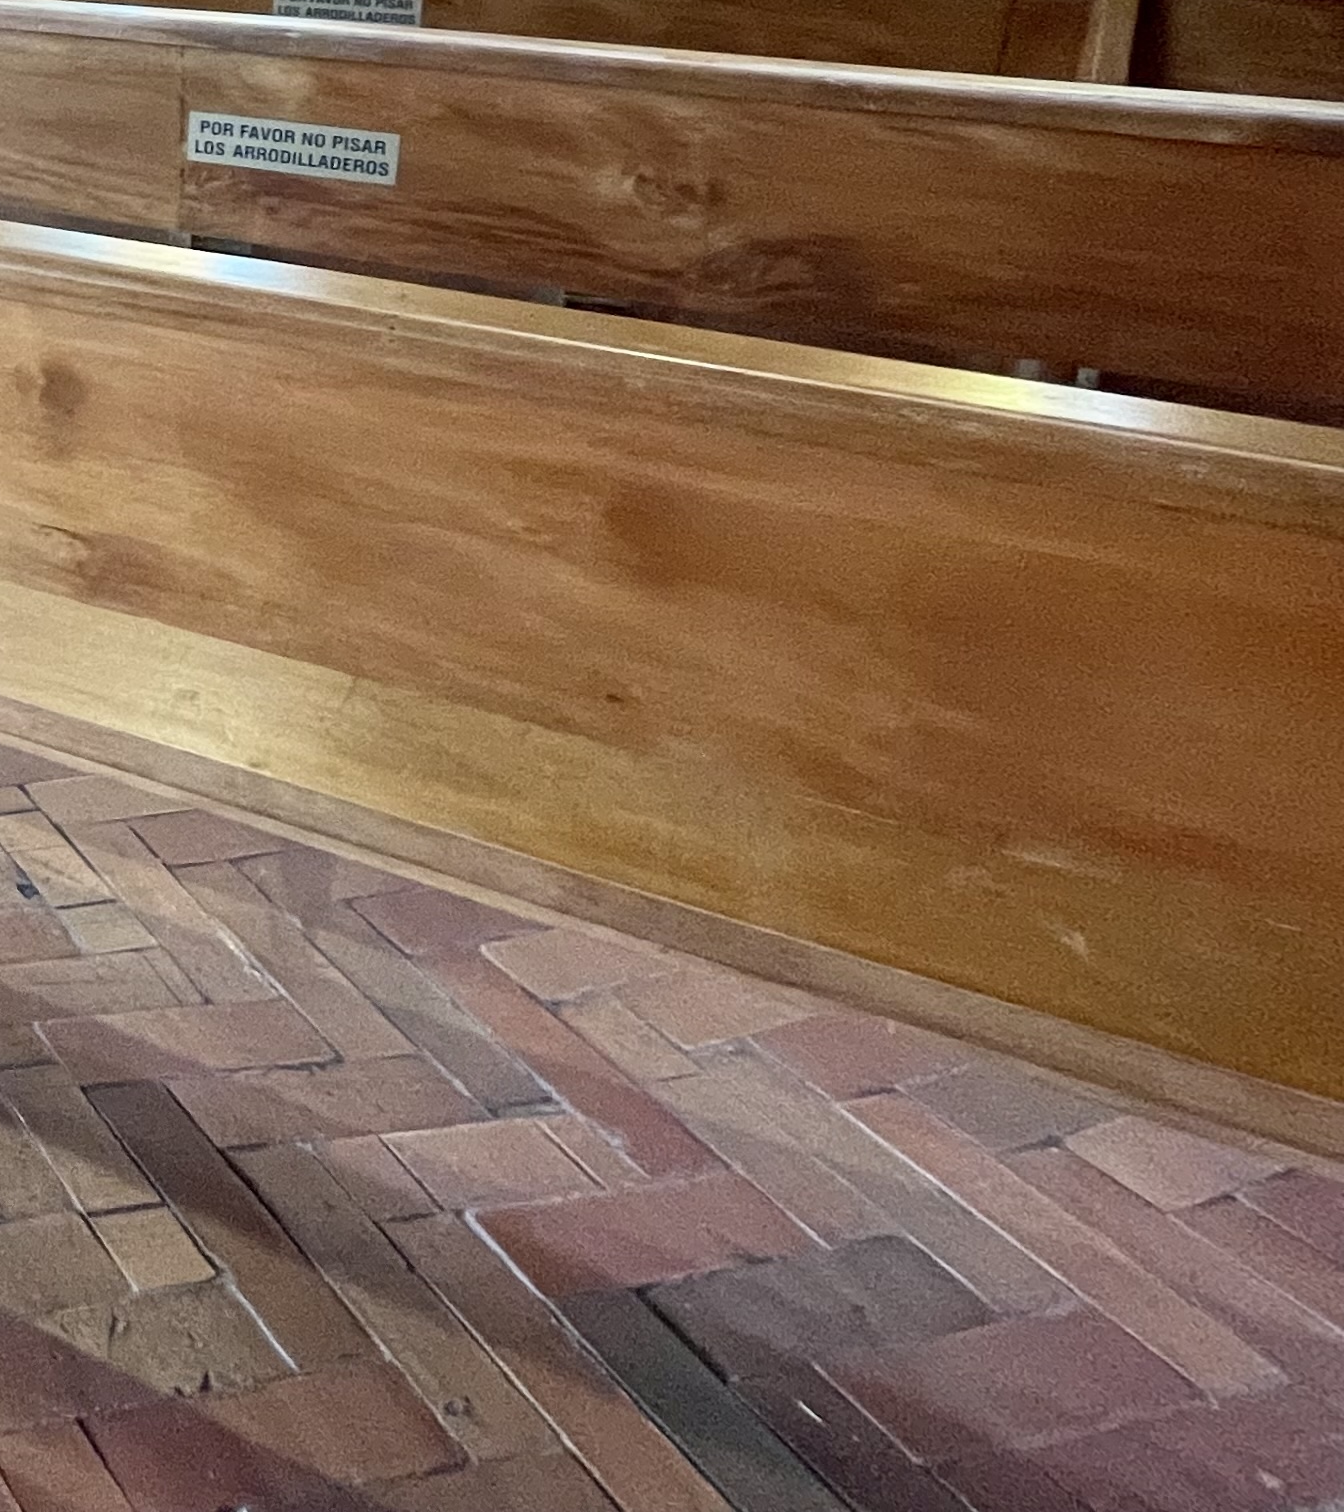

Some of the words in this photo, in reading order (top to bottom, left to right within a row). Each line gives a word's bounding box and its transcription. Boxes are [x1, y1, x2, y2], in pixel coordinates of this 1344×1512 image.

[278, 5, 300, 17] LOS
[305, 6, 416, 25] ARRODILLADEROS
[200, 120, 234, 137] POR
[240, 125, 295, 144] FAVOR
[301, 132, 326, 148] NO
[332, 135, 387, 155] PISAR
[194, 140, 225, 156] LOS
[233, 145, 390, 177] ARRODILLADEROS
